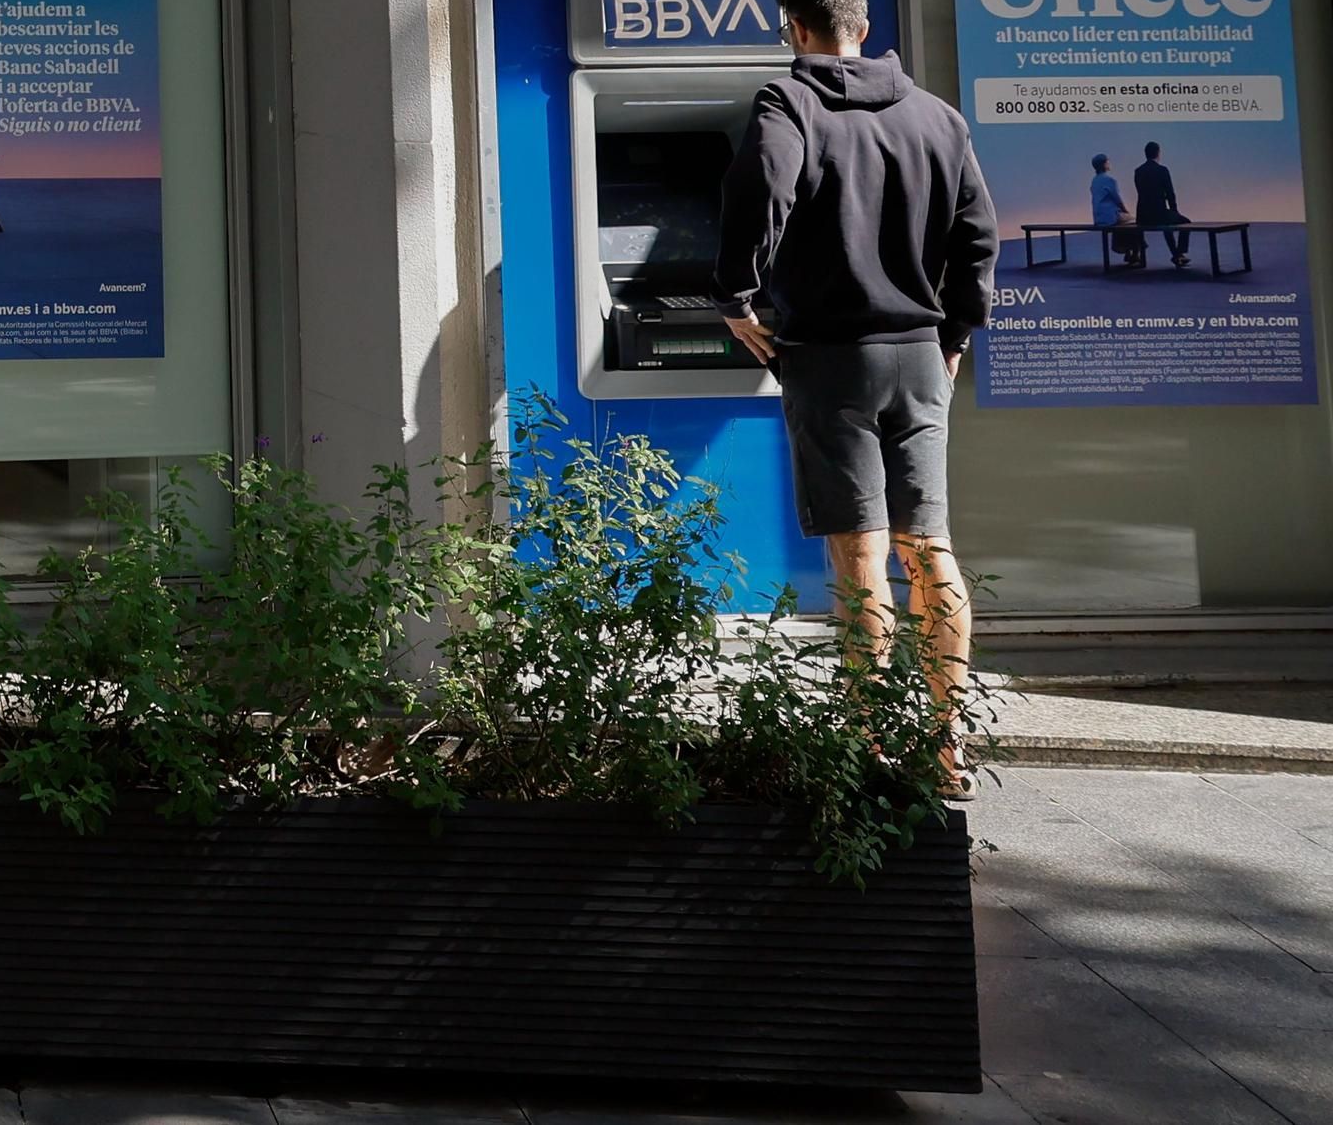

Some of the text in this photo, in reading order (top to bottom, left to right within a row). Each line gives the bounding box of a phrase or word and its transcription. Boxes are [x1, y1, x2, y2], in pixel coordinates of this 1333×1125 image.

[75, 5, 85, 16] a
[95, 20, 118, 35] les
[995, 25, 1252, 42] al banco líder en rentabilidad
[44, 40, 109, 55] accions
[113, 40, 133, 54] de
[1016, 52, 1027, 68] y
[1030, 47, 1137, 64] crecimiento
[1140, 51, 1162, 63] en
[44, 58, 118, 74] Sabadell
[6, 82, 16, 93] a
[19, 80, 92, 97] acceptar
[1013, 83, 1242, 98] Te ayudamos en esta oficina o en el
[61, 98, 82, 112] de
[86, 98, 139, 112] BBVA.
[996, 101, 1023, 113] 800
[1027, 101, 1055, 112] 080
[1093, 100, 1123, 112] Seas
[1127, 103, 1134, 111] o
[1139, 103, 1153, 111] no
[1157, 101, 1198, 111] cliente
[1203, 101, 1217, 111] de
[1222, 99, 1261, 111] BBVA.
[54, 121, 64, 131] o
[67, 120, 89, 131] no
[93, 117, 140, 131] client
[99, 283, 146, 291] Avancem?
[35, 303, 38, 314] i
[42, 305, 49, 314] a
[54, 302, 115, 313] bbva.com
[988, 314, 1297, 331] Folleto disponible en cnmv.es y en bbva.com
